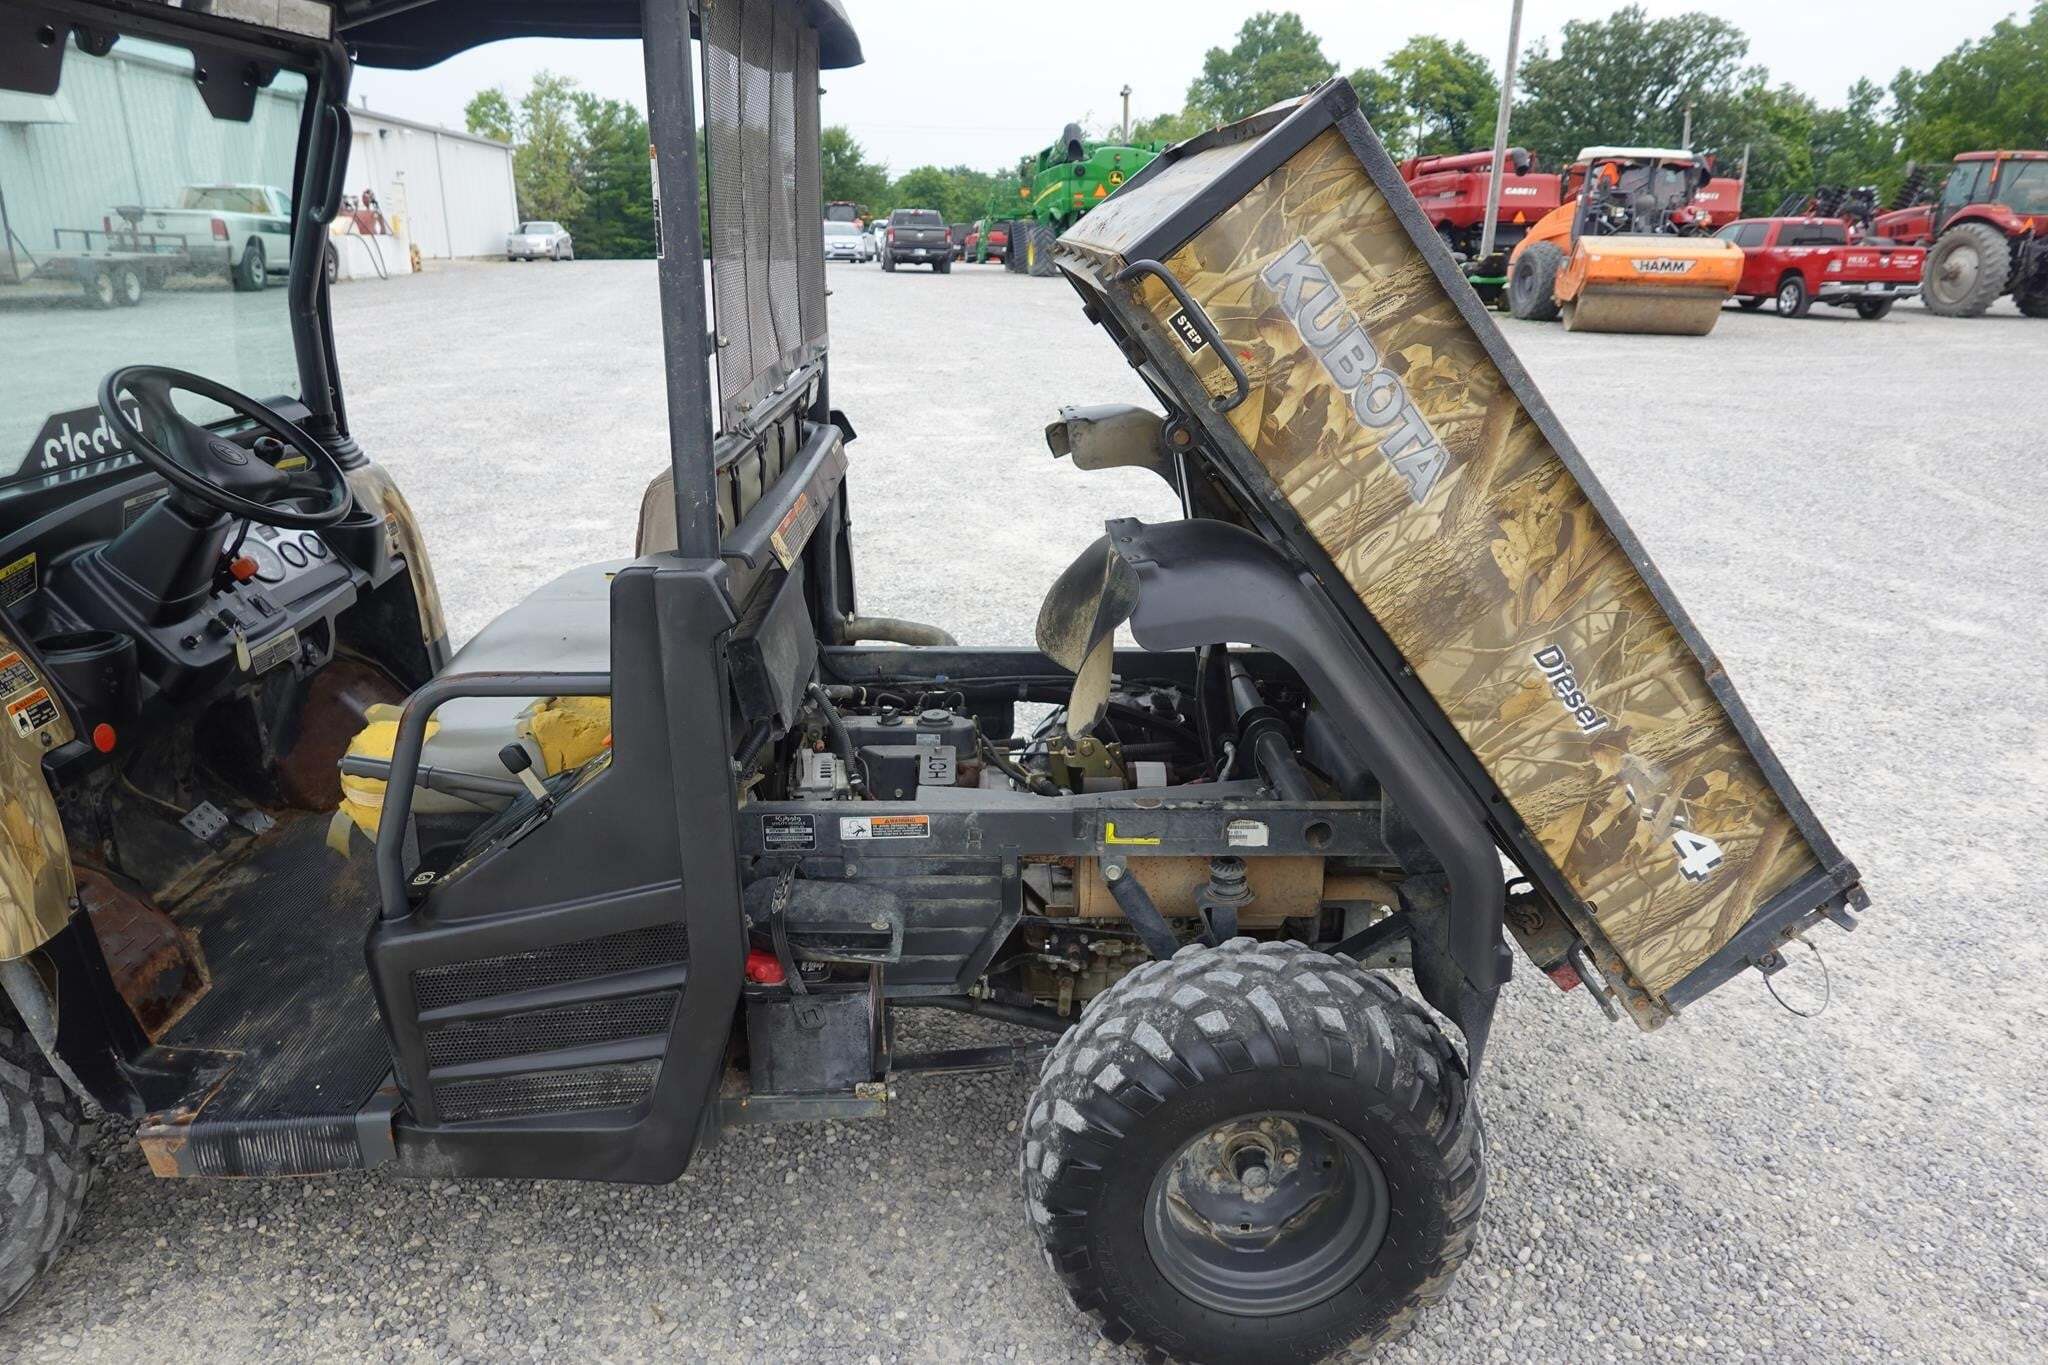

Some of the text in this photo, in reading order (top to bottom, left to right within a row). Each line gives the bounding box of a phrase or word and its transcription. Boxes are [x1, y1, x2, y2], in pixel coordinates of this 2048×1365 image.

[1639, 261, 1686, 273] HAMM
[1177, 315, 1202, 344] STEP
[1262, 237, 1449, 503] KUBOTA
[1532, 644, 1609, 736] Diesel
[928, 756, 947, 779] HOT
[1672, 829, 1727, 885] 4
